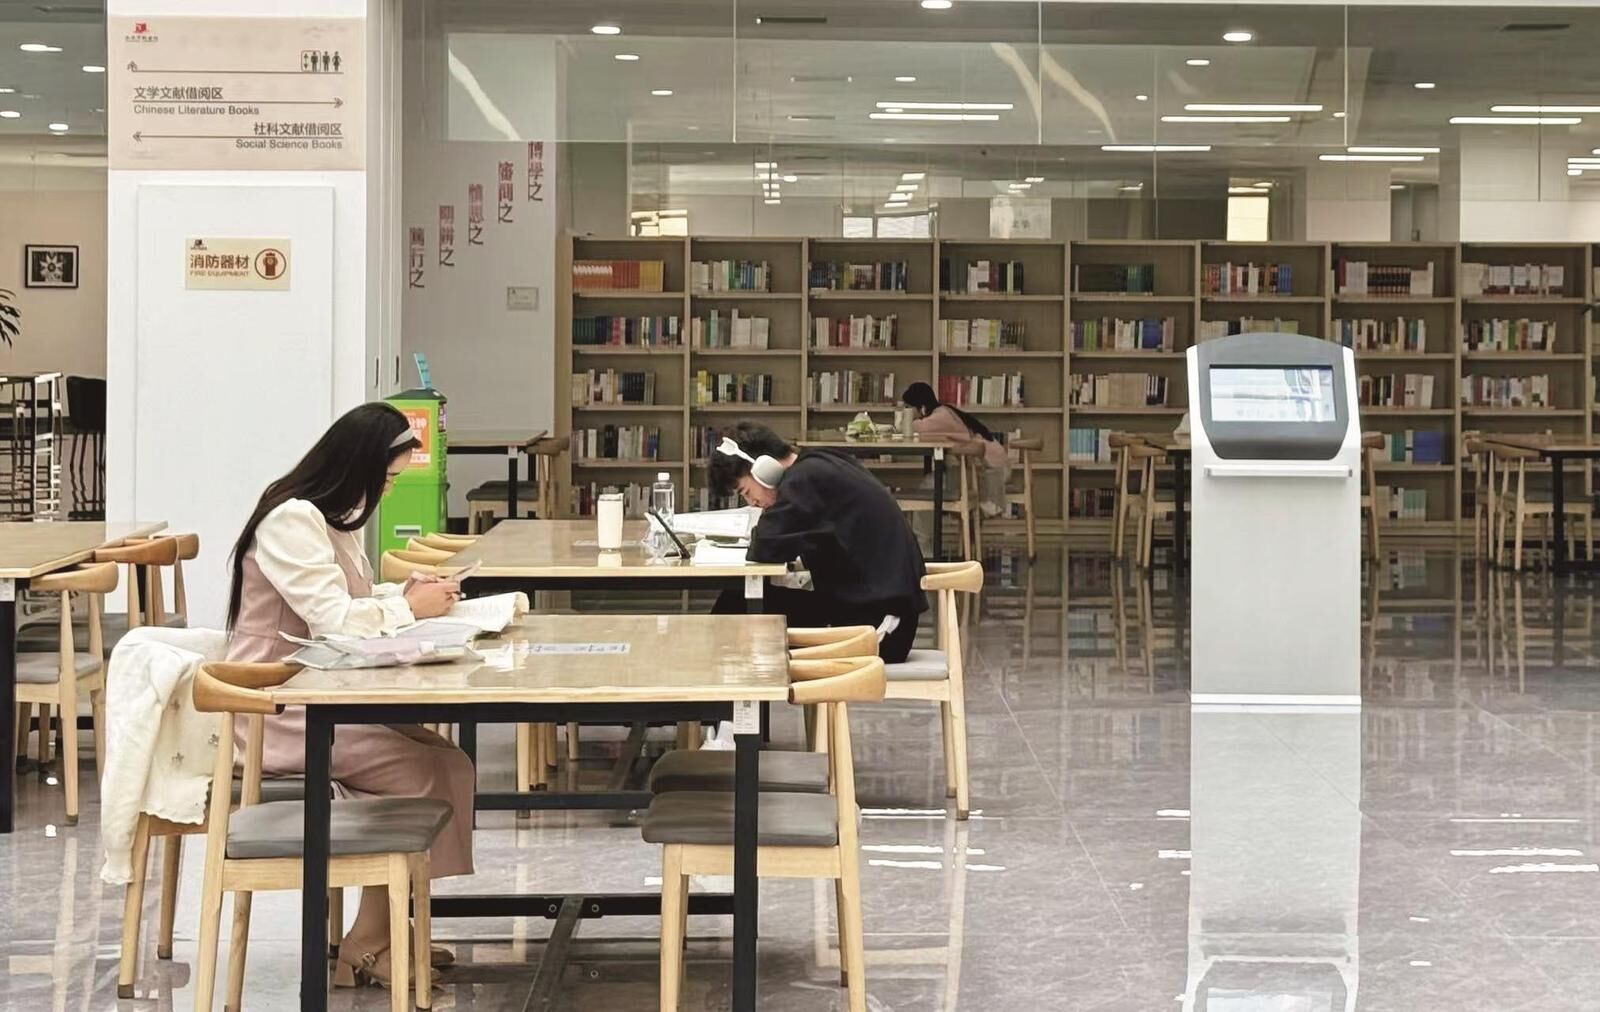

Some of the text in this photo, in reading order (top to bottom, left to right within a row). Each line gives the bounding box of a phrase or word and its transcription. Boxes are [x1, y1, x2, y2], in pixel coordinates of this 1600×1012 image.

[134, 86, 223, 100] 文学文献借阅区
[134, 104, 260, 116] Chinese Literature Books
[254, 122, 342, 136] 社科文献借阅区
[236, 138, 342, 150] Social Science Books
[190, 254, 250, 269] 消防器材
